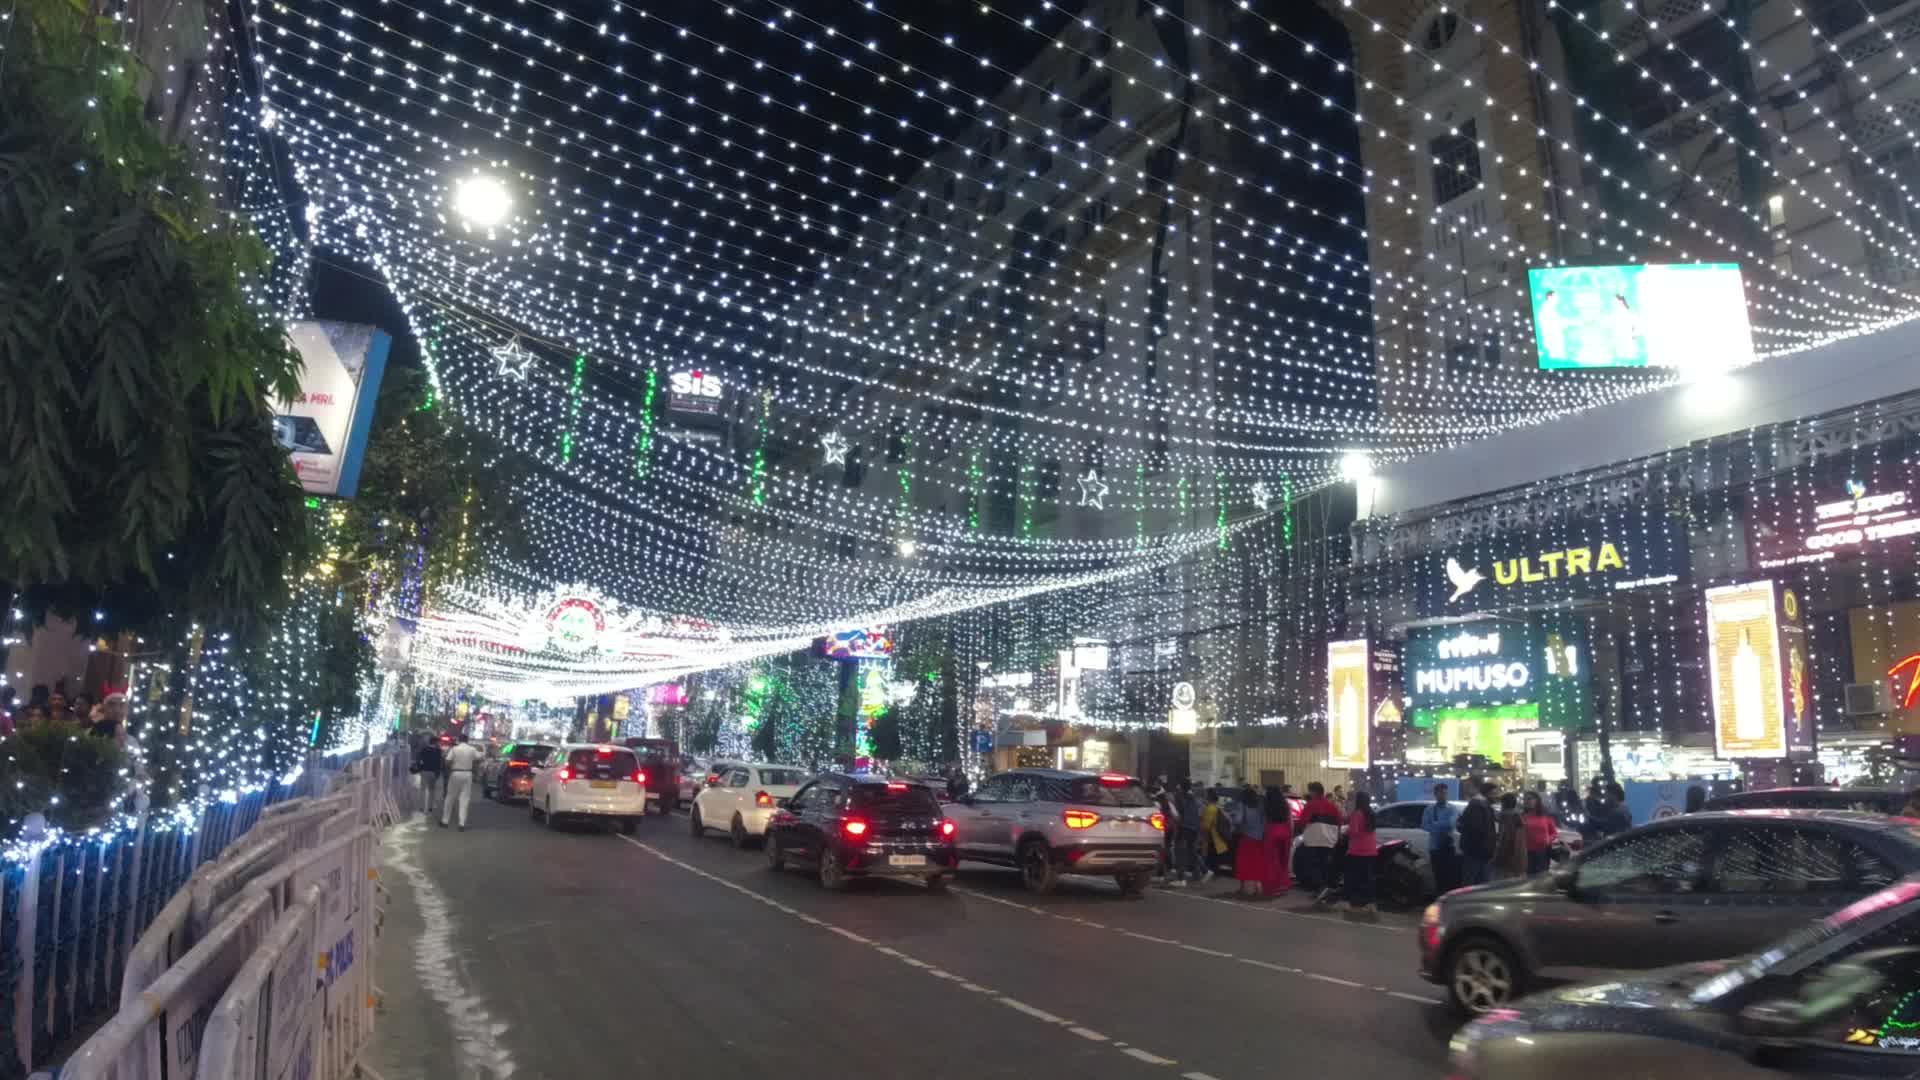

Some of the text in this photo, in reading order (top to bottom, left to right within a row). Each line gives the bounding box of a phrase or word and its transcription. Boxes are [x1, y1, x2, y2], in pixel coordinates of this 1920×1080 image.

[1806, 529, 1863, 549] GOOD
[1493, 543, 1624, 585] ULTRA
[1415, 662, 1529, 694] MUMUSO
